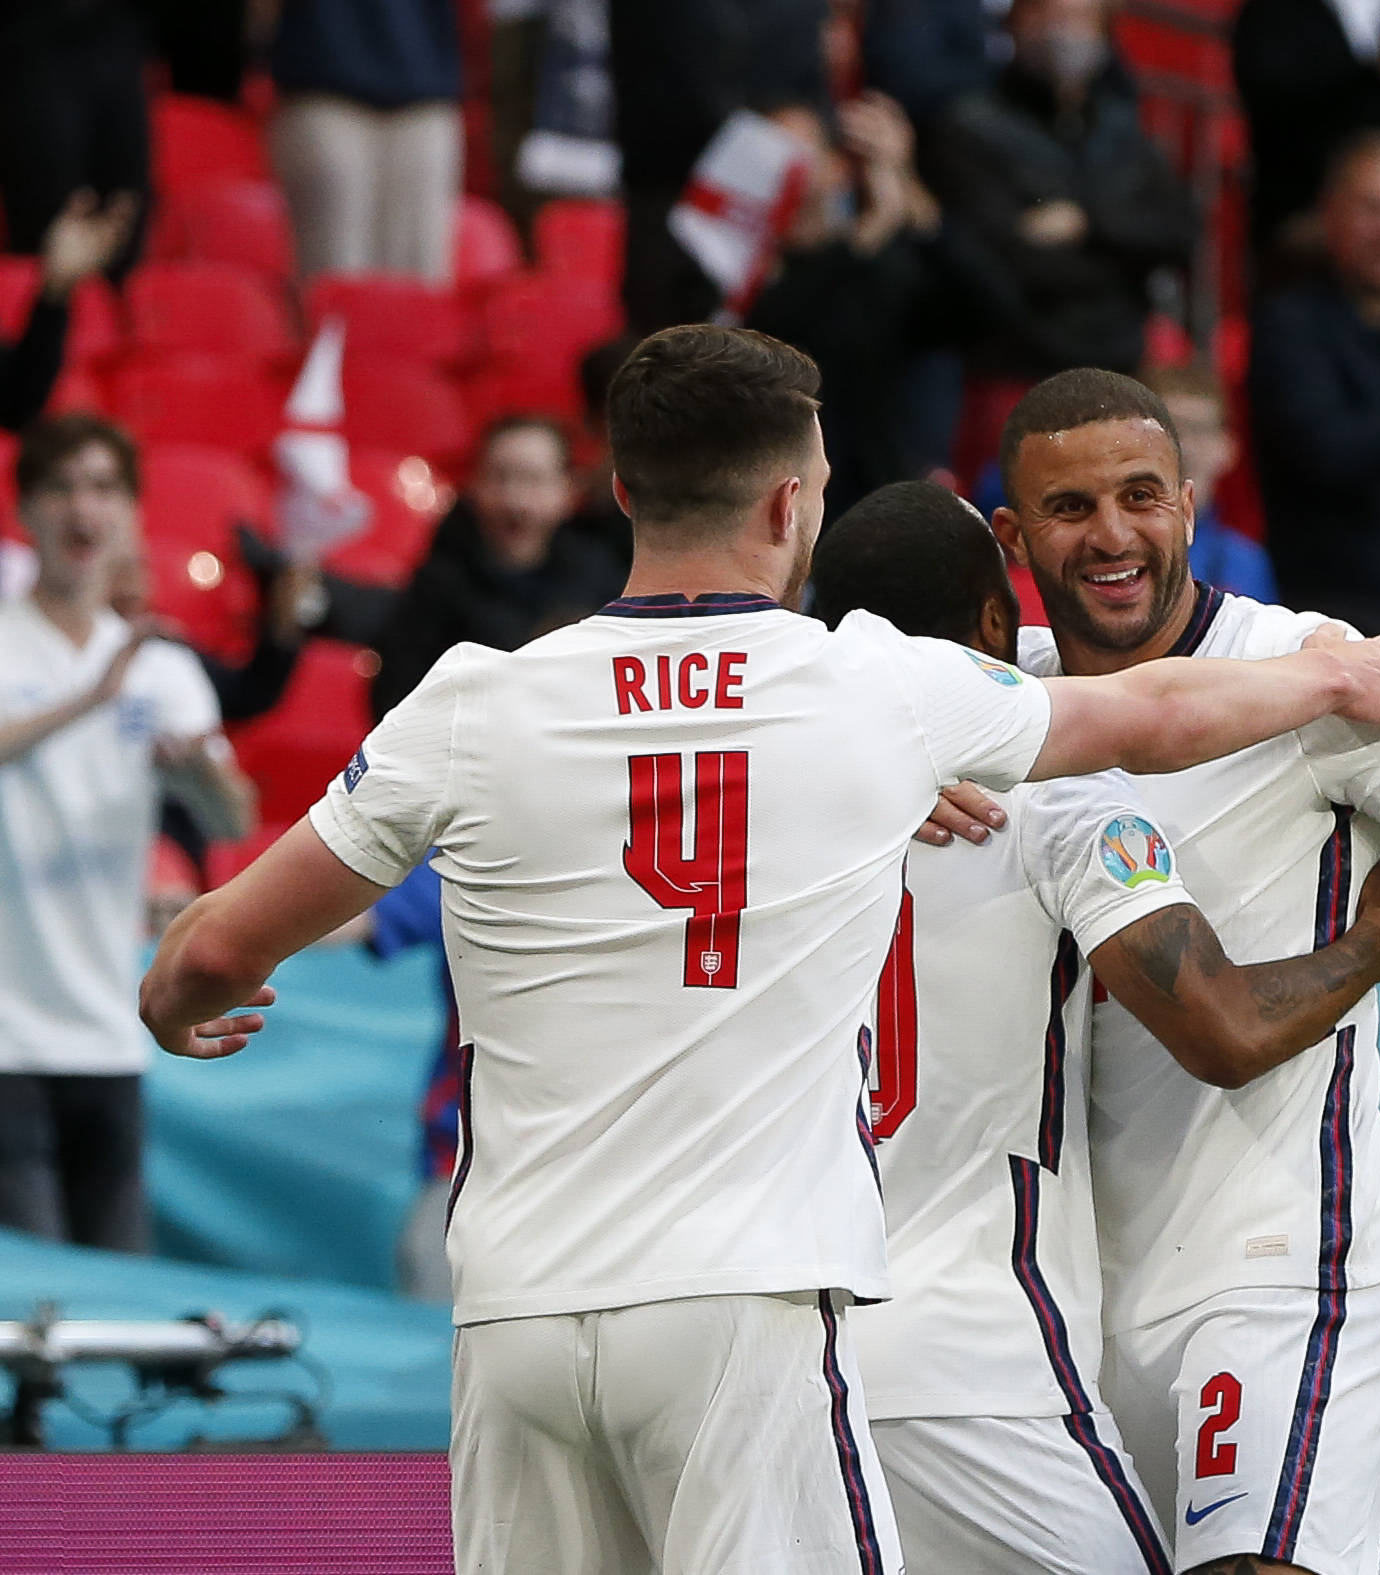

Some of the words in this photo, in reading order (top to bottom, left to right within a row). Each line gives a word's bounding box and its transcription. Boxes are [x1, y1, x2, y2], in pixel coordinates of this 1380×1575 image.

[612, 652, 748, 715] RICE
[622, 751, 749, 990] 4
[1195, 1371, 1243, 1480] 2
